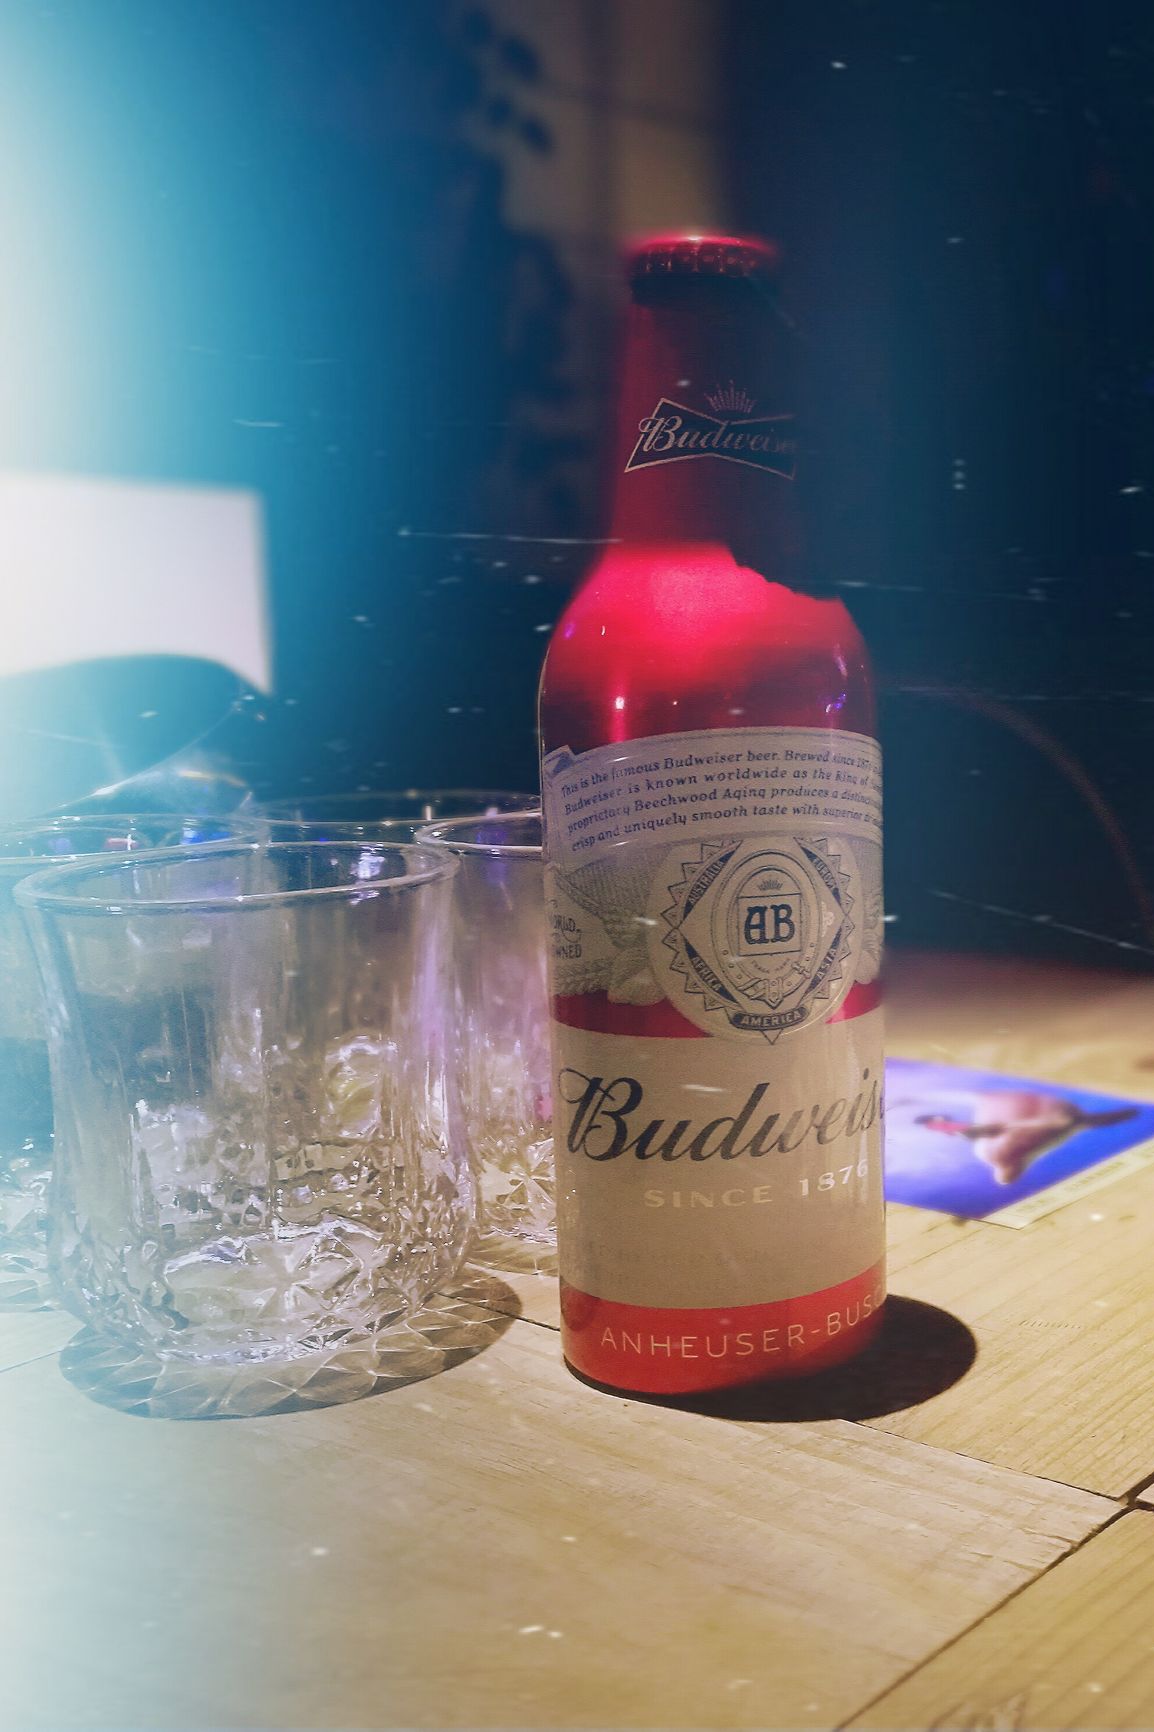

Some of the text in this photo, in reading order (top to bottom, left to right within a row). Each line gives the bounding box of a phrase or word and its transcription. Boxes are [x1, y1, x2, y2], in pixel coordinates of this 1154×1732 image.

[664, 752, 743, 769] Budweiser
[785, 750, 830, 762] Brewed
[628, 783, 641, 794] is
[646, 774, 697, 791] known
[704, 766, 787, 782] worldwide
[793, 770, 807, 779] as
[812, 767, 831, 780] the
[634, 789, 717, 812] Beechwood
[770, 786, 829, 802] produces
[623, 812, 687, 834] uniquely
[692, 804, 748, 822] smooth
[753, 804, 787, 816] taste
[792, 803, 819, 815] with
[743, 903, 795, 945] AB
[817, 948, 837, 980] ASIA
[741, 1010, 803, 1027] AMERICA
[644, 1158, 868, 1208] SINCE 1876
